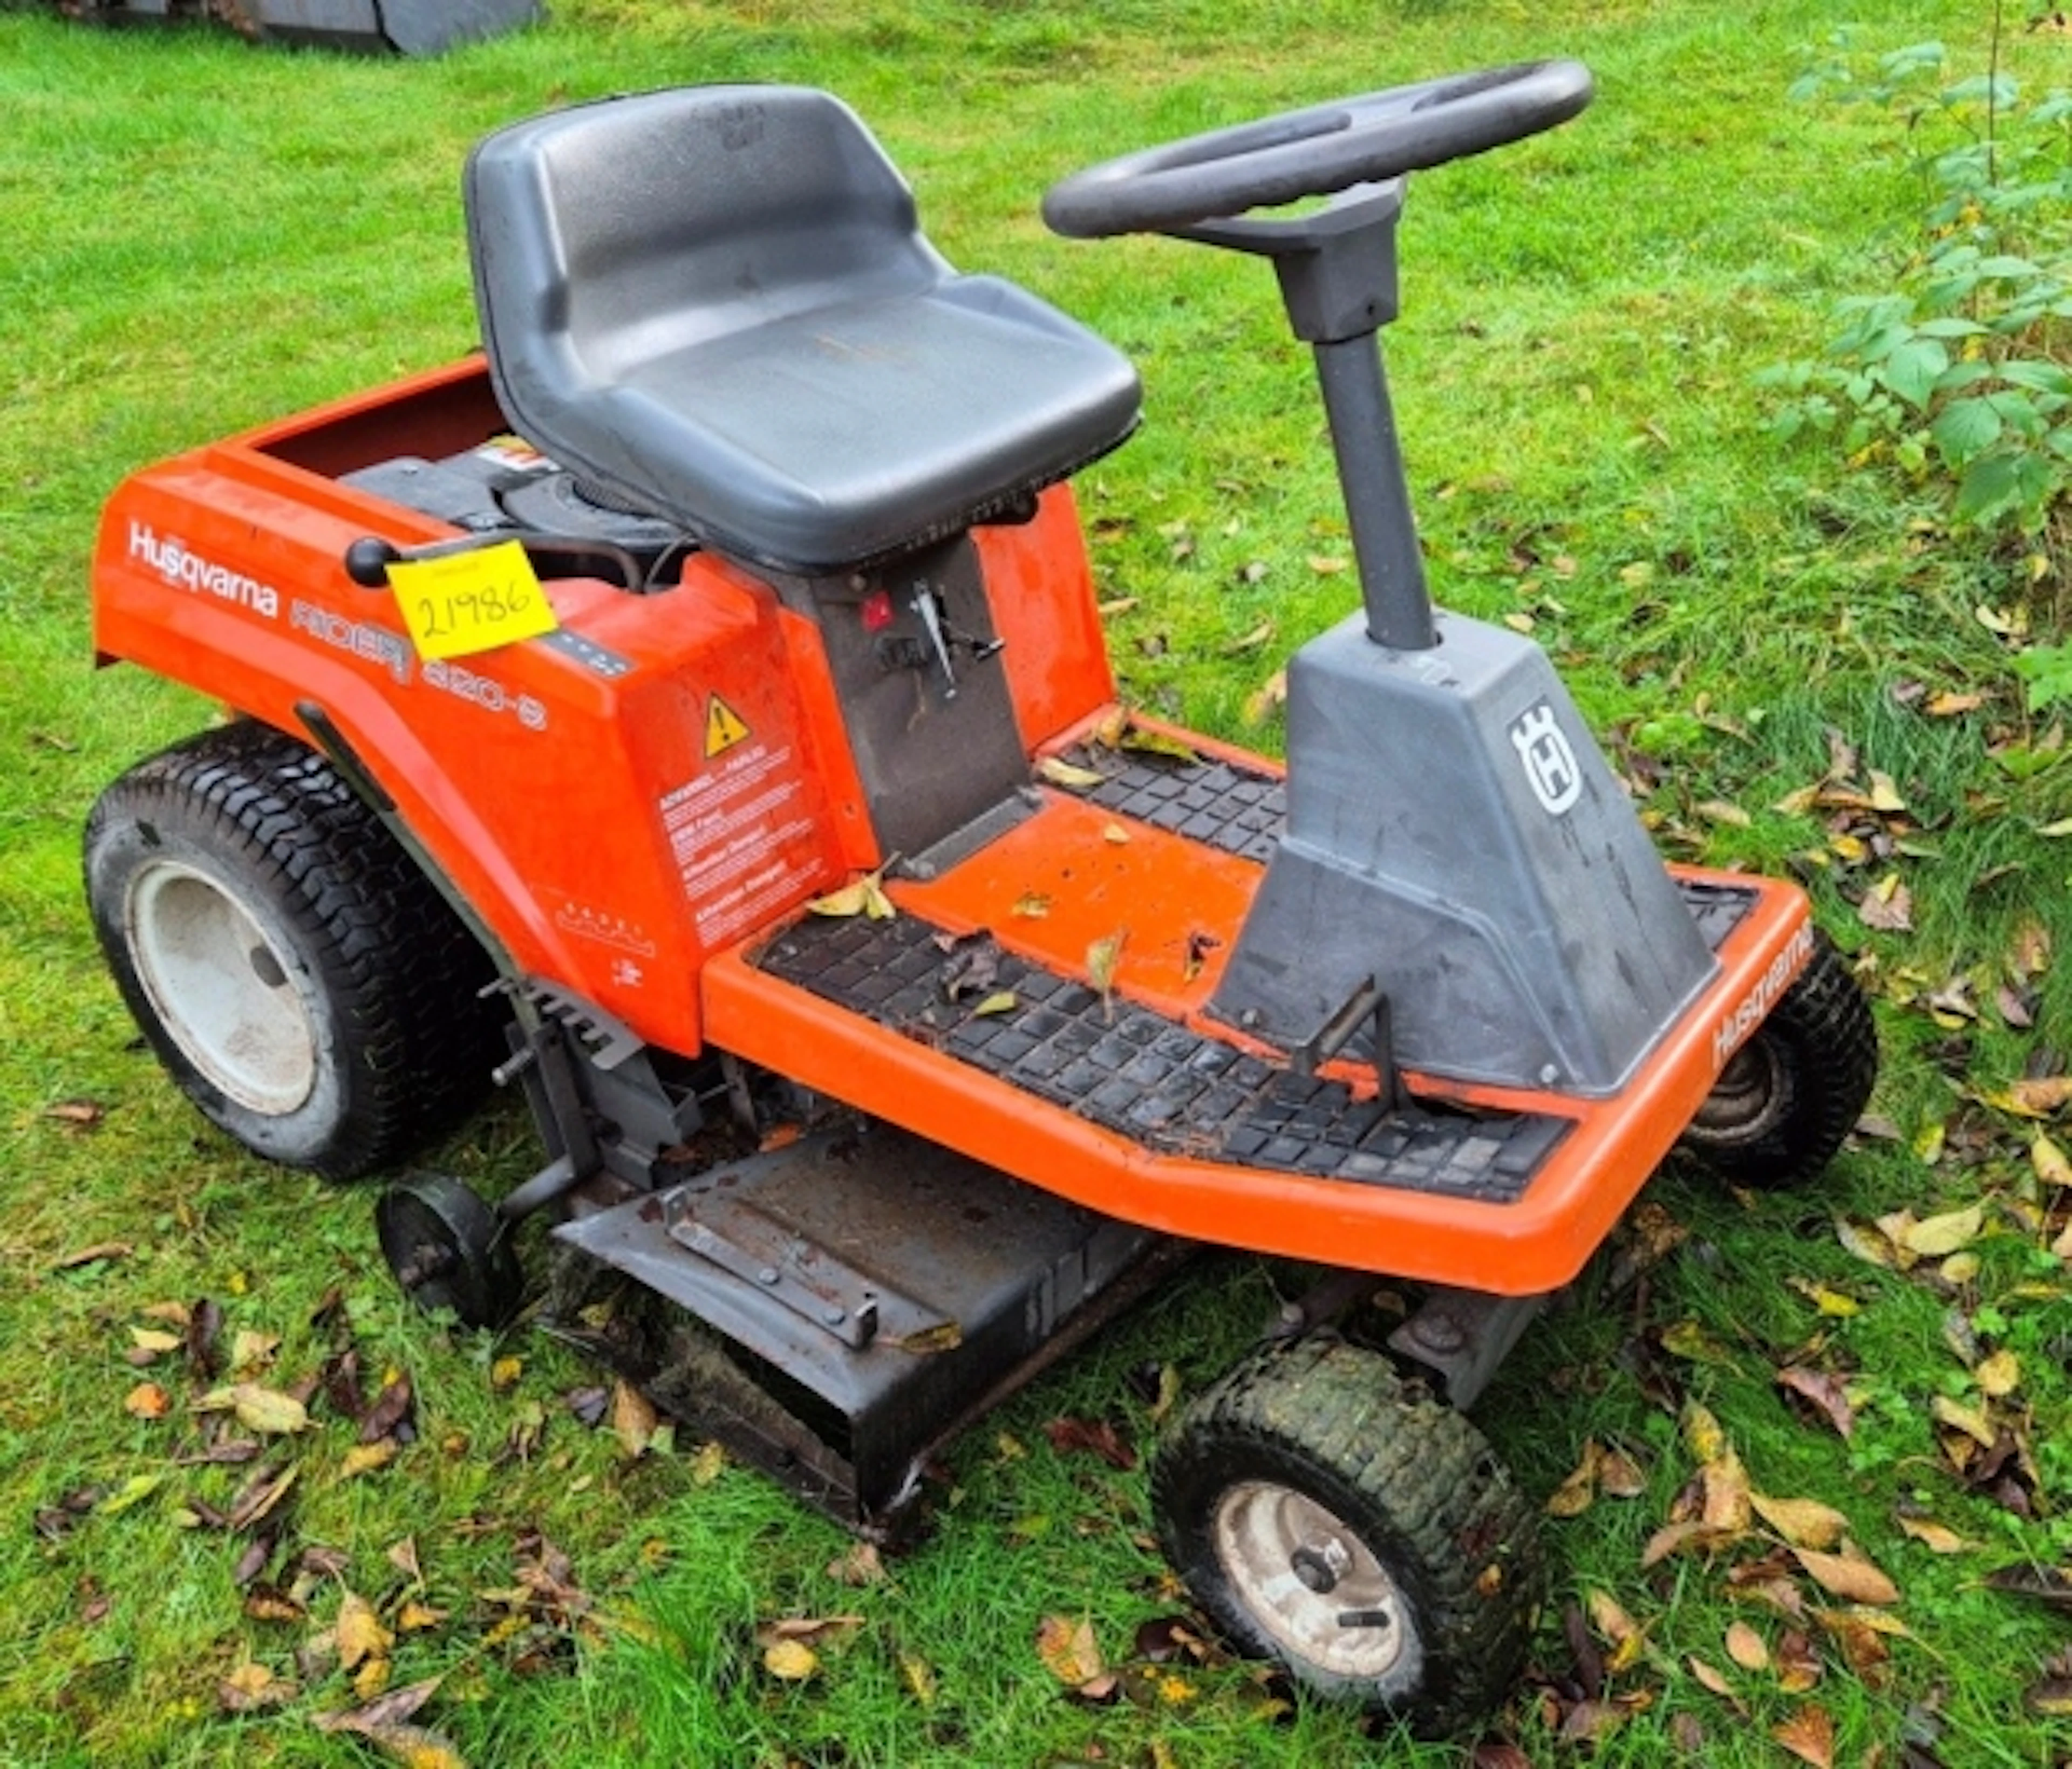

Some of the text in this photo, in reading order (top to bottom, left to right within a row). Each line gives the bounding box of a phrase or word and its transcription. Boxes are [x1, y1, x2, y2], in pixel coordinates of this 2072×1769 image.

[129, 521, 278, 619] Husqvarna
[289, 597, 413, 686] RIDER
[419, 580, 530, 638] 21986
[1712, 916, 1814, 1071] Husqvarna
